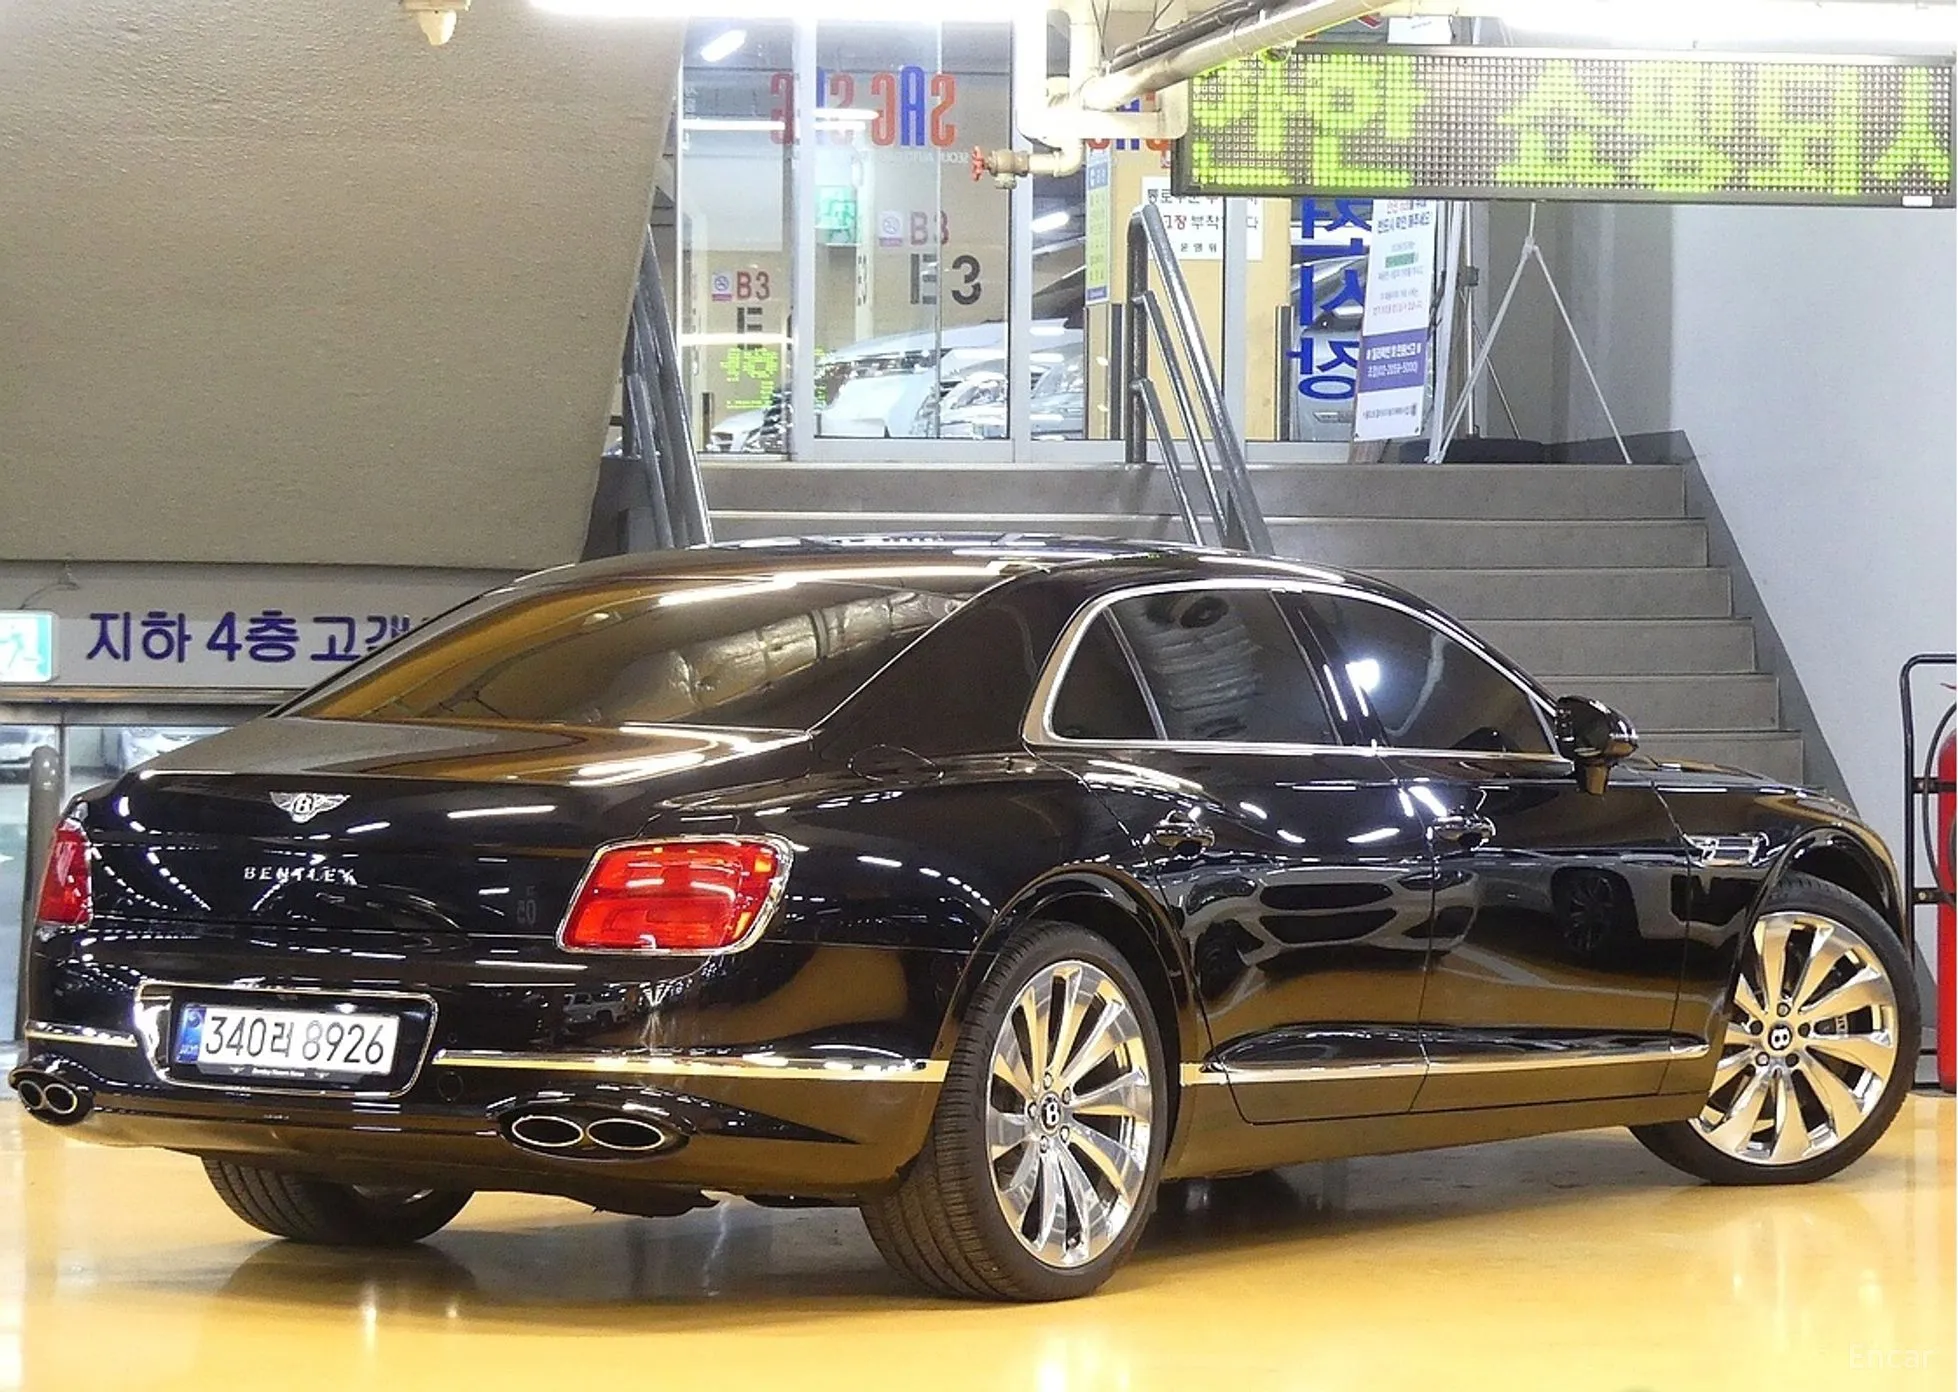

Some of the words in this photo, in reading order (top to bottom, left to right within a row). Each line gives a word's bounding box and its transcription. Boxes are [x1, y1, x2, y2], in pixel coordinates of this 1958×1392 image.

[910, 209, 950, 246] B3
[736, 271, 771, 301] B3
[86, 611, 193, 664] 지하
[206, 610, 300, 662] 4층
[310, 613, 429, 662] 고객
[243, 865, 357, 885] BENTLEY
[302, 1019, 385, 1065] 8926
